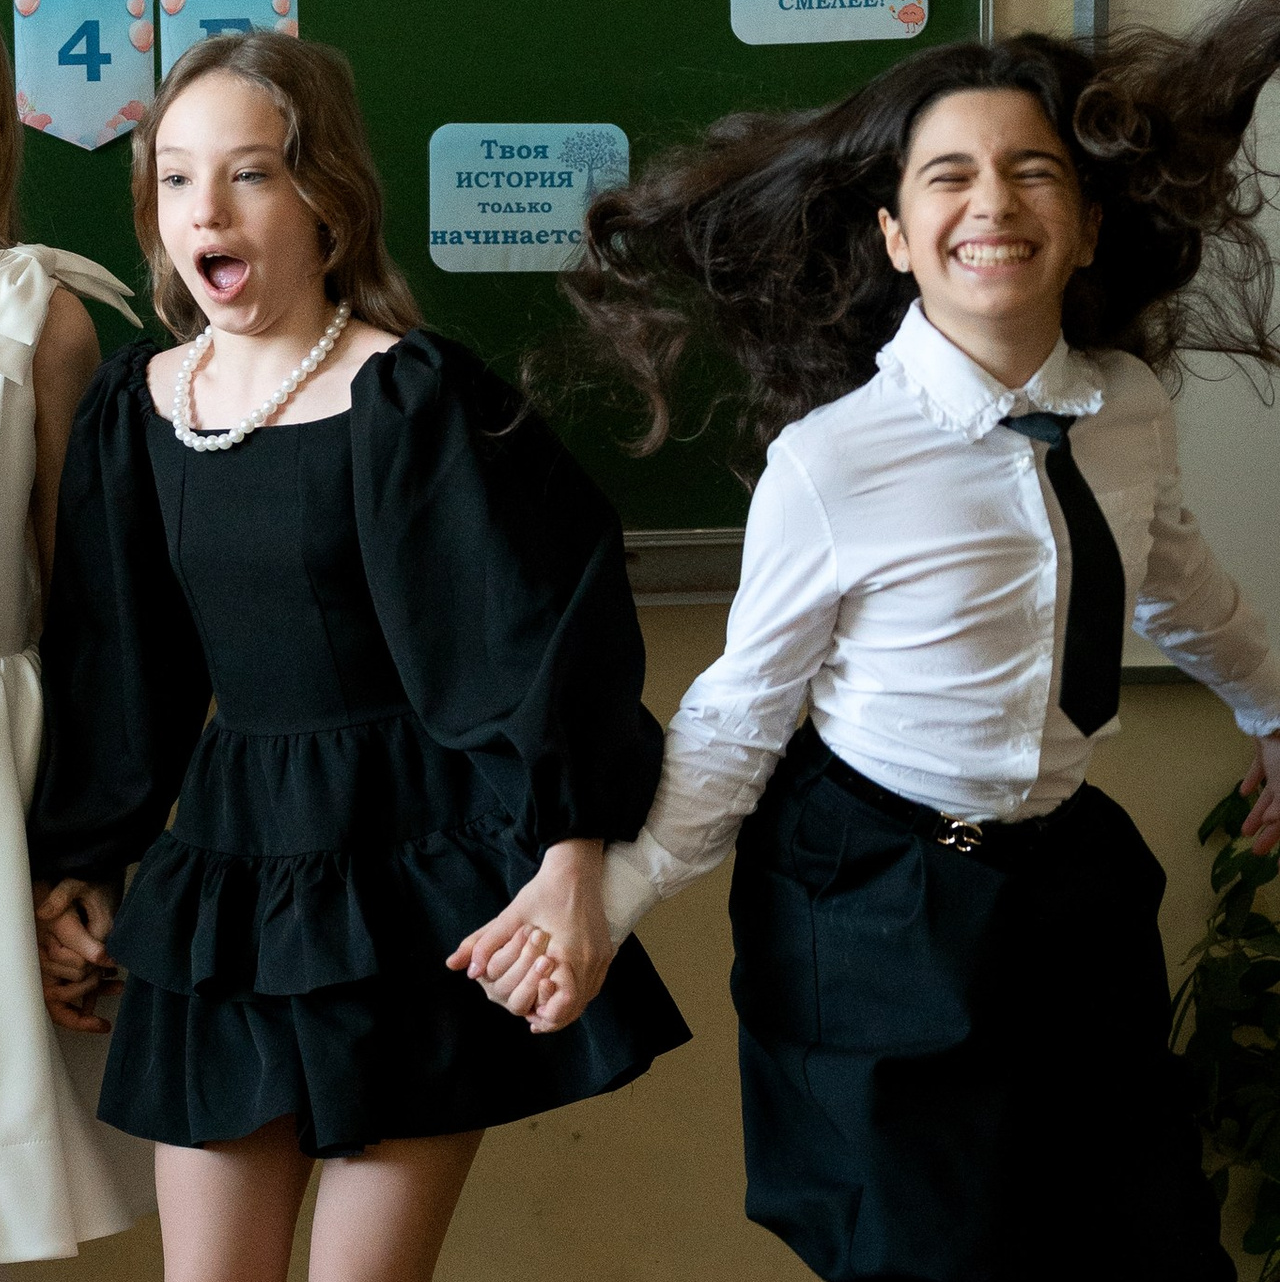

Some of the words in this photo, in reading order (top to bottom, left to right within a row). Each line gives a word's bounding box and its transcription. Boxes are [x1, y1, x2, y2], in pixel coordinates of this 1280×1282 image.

[481, 139, 549, 160] Твоя
[456, 172, 573, 188] ИСТОРИЯ
[478, 202, 552, 213] только
[431, 229, 581, 245] начинаетс
